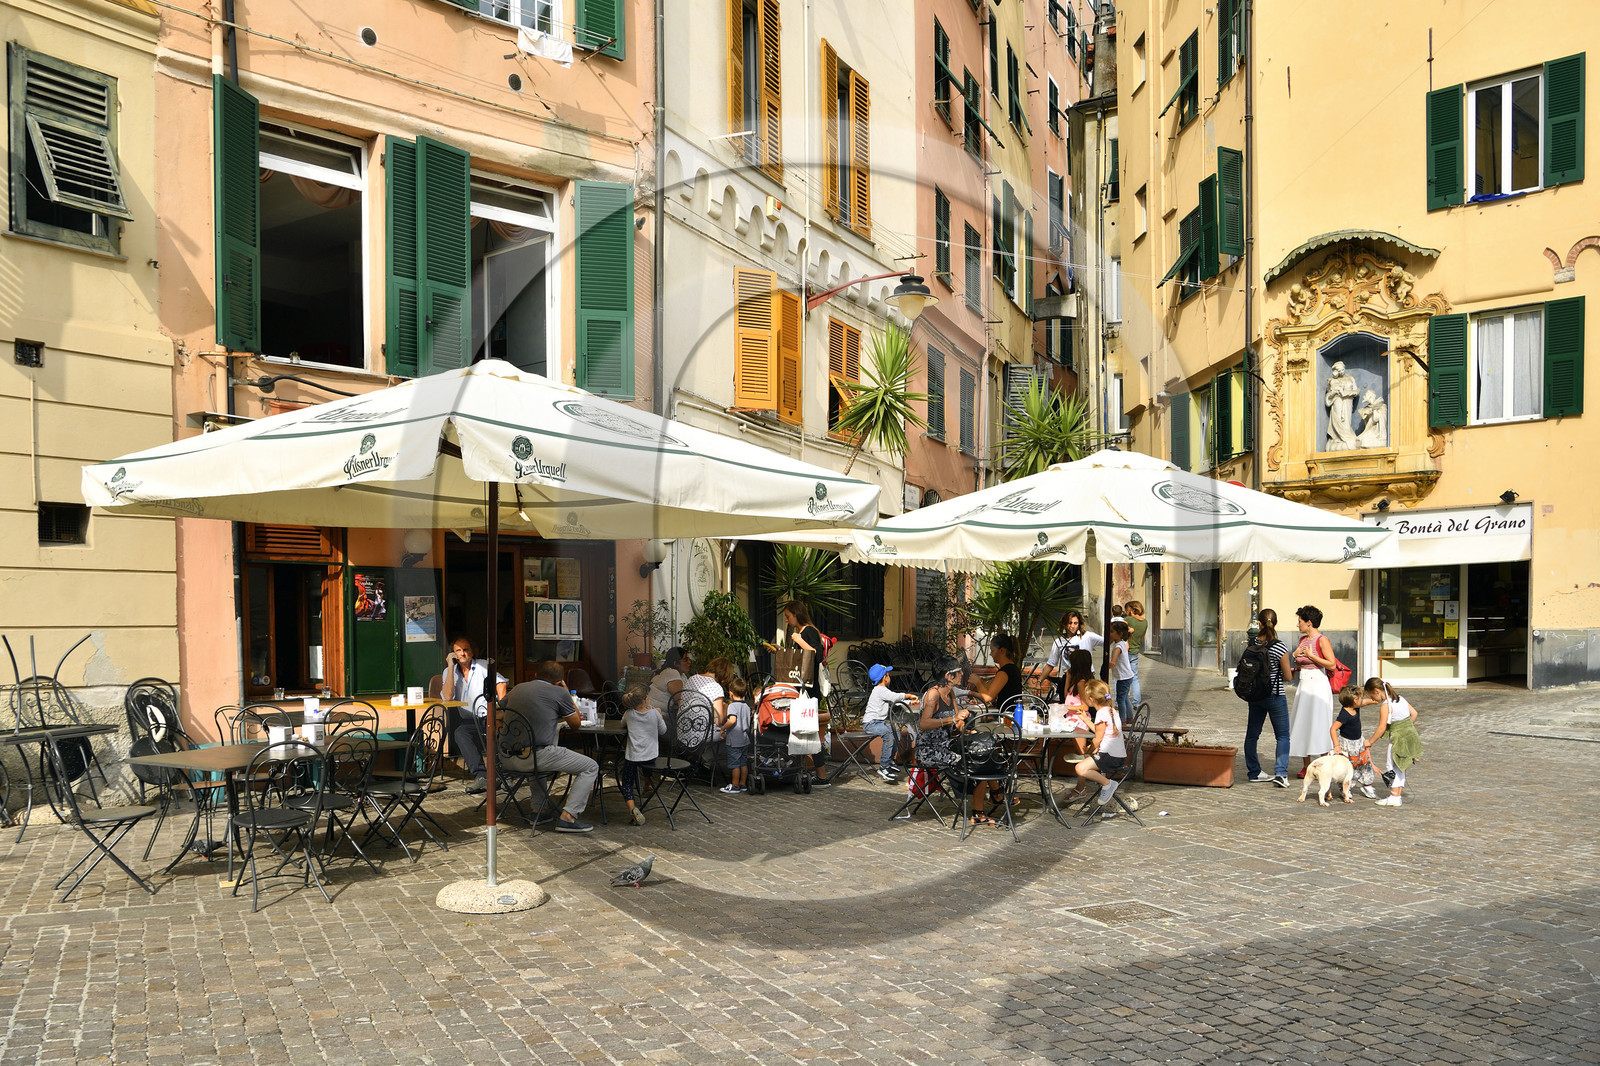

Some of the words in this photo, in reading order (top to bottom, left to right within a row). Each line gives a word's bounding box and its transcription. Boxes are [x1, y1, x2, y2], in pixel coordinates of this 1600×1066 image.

[534, 457, 567, 480] Urquell
[1395, 520, 1442, 535] Bontà
[1447, 518, 1470, 532] del
[1474, 515, 1527, 535] Grano
